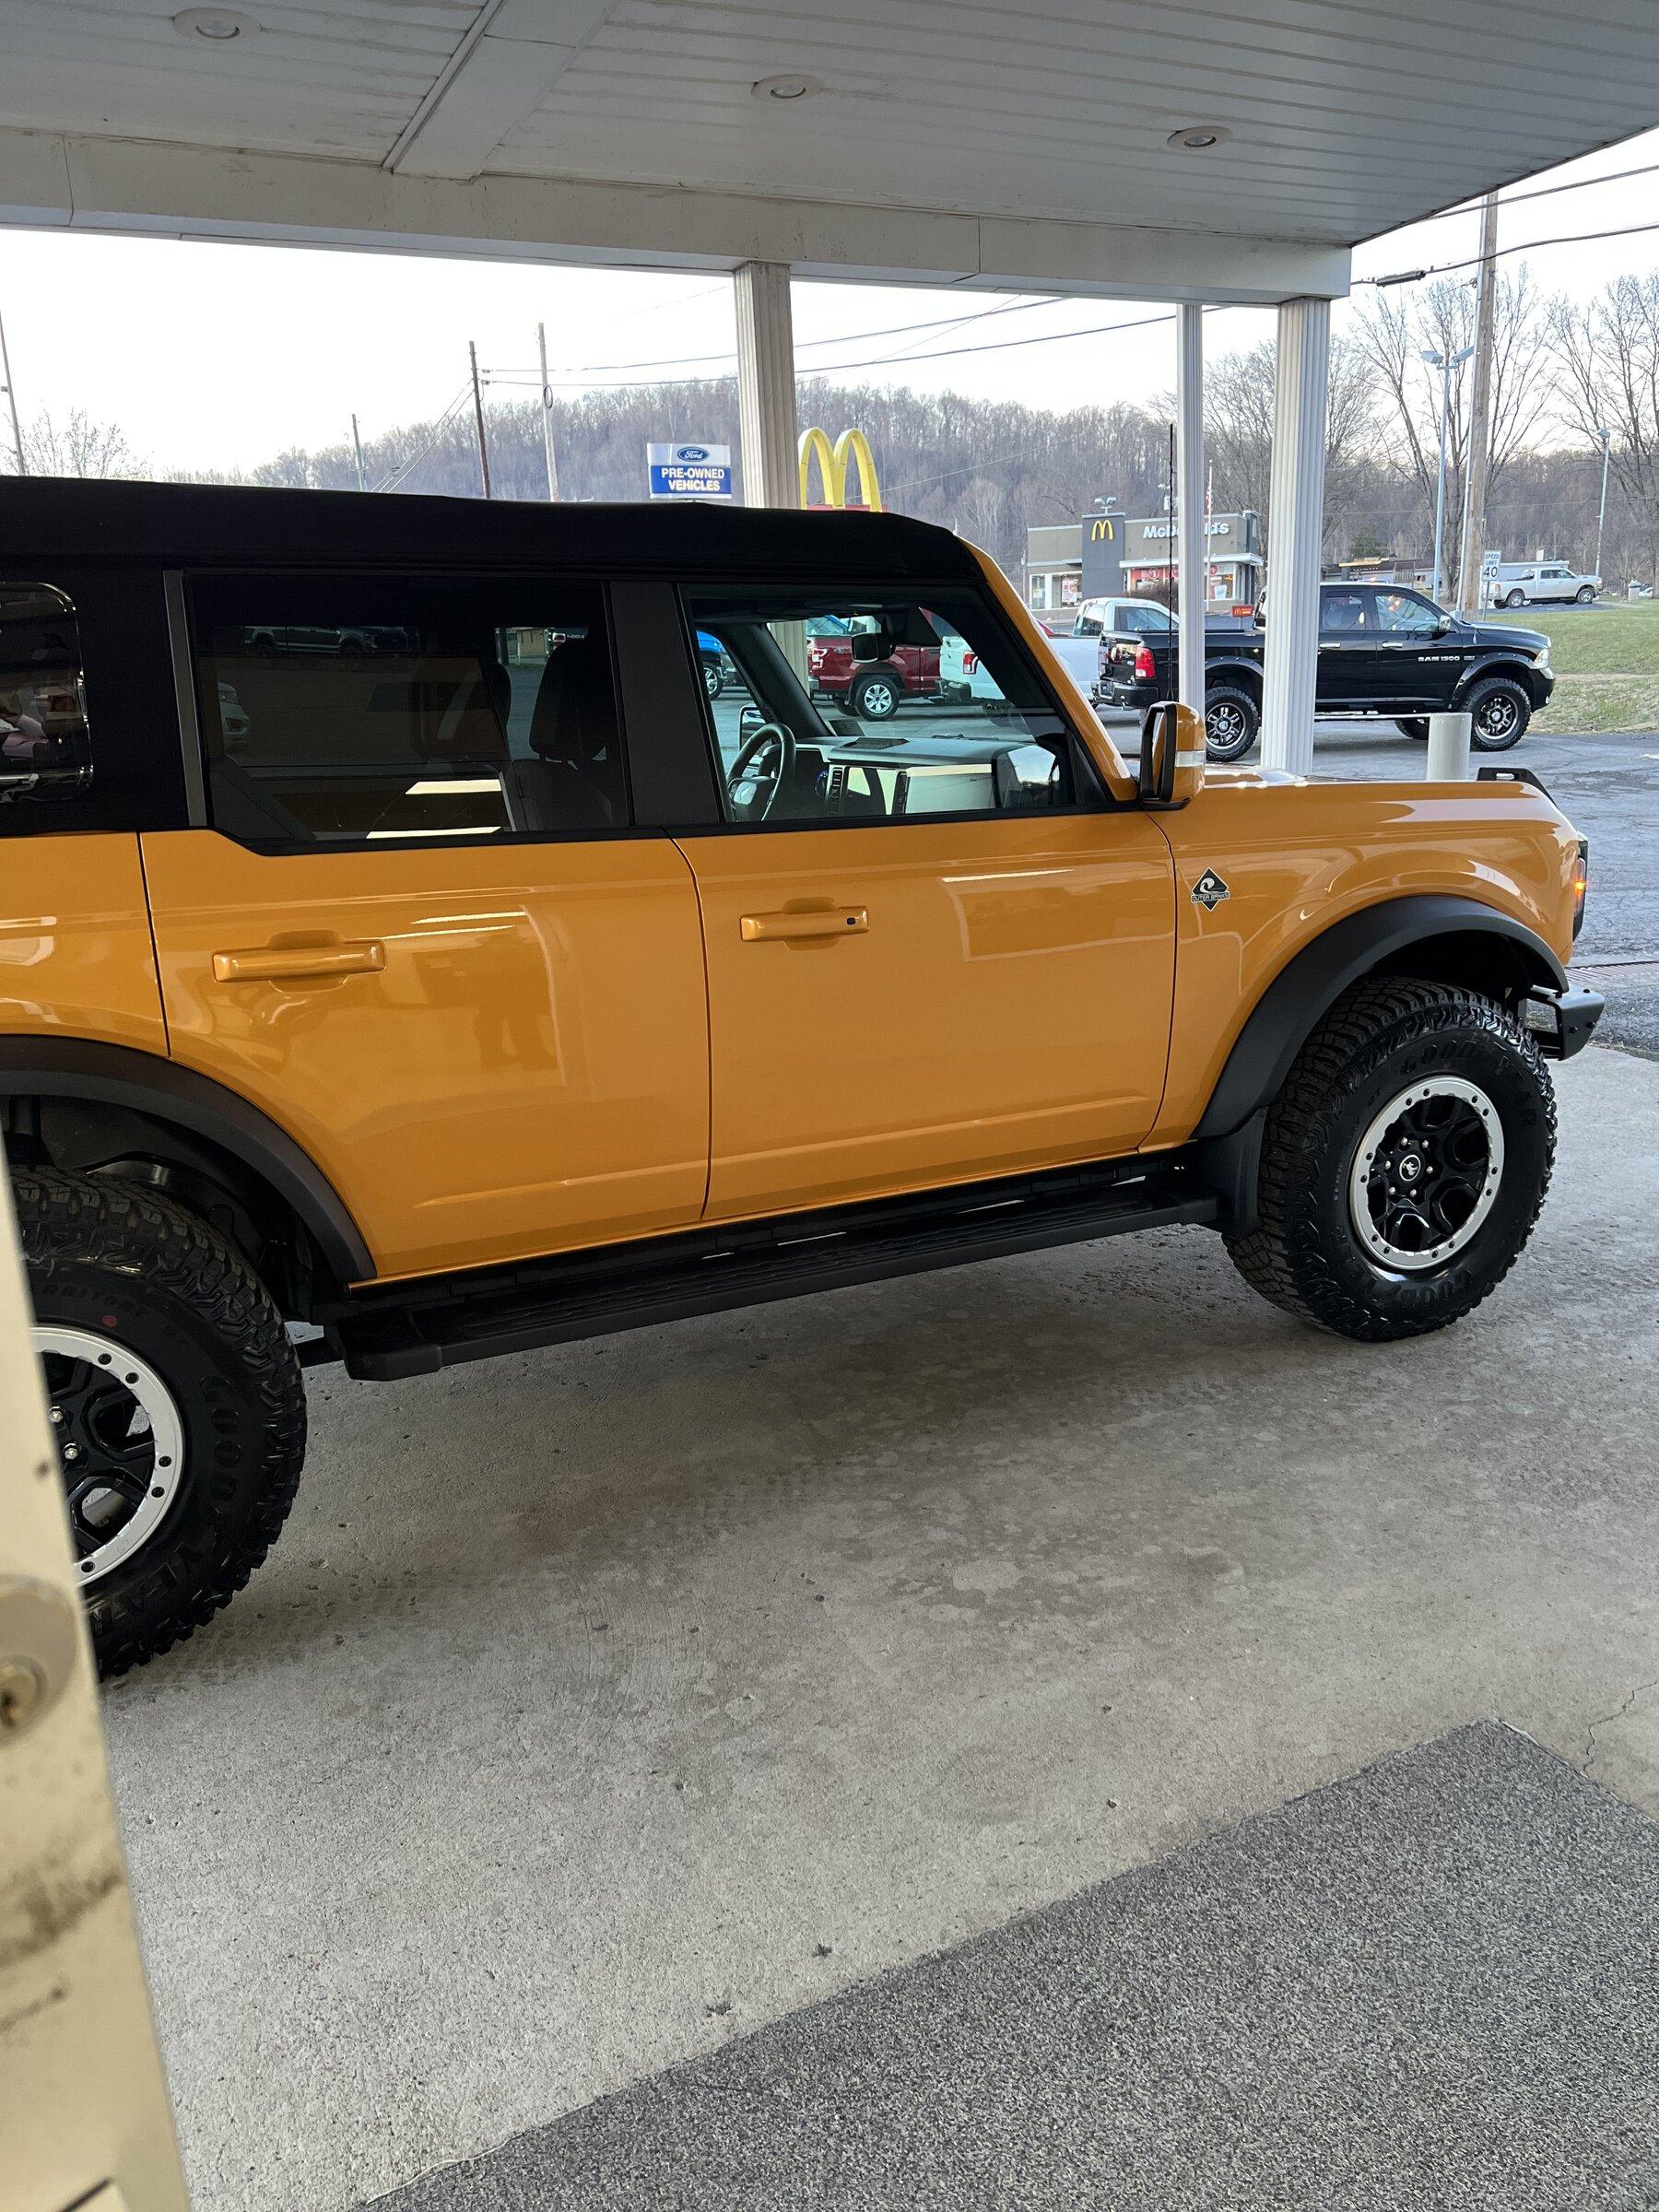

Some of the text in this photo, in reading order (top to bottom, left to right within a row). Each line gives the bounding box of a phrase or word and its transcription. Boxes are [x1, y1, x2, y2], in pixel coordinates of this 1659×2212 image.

[684, 450, 703, 459] Ford
[661, 467, 725, 479] PRE-OWNED
[668, 479, 721, 491] VEHICLES
[1483, 566, 1498, 578] 40
